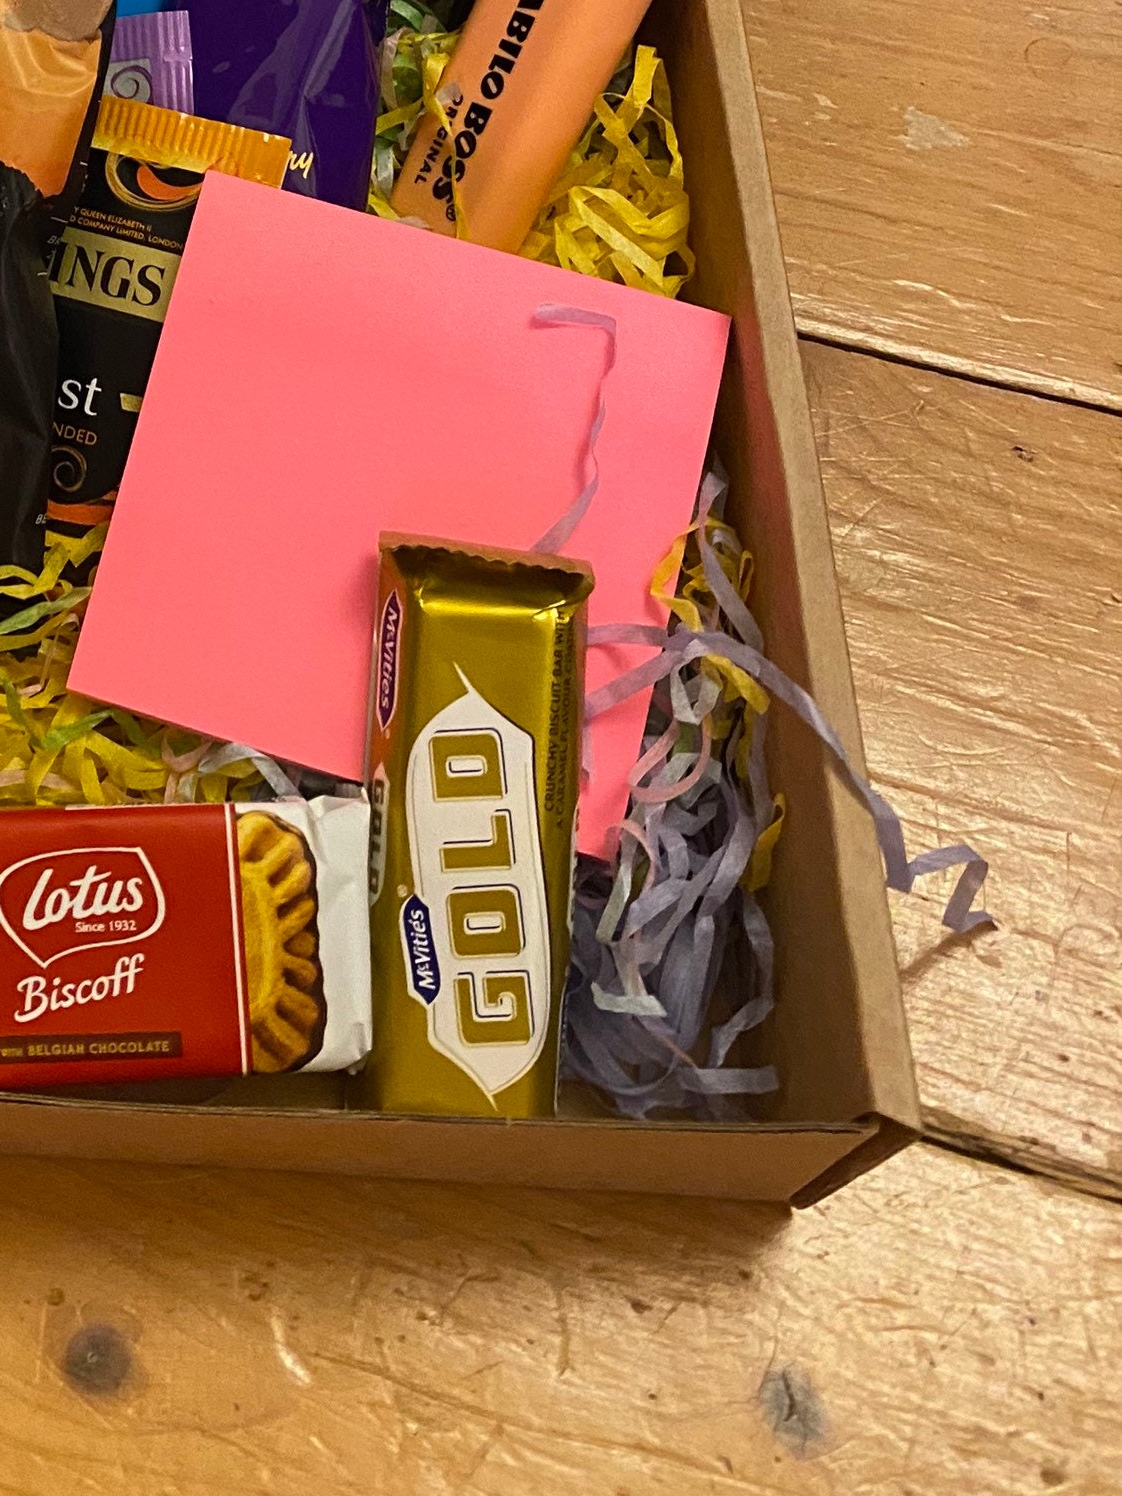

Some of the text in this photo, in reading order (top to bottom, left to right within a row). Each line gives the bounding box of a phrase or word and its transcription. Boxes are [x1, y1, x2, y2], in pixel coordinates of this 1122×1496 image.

[433, 102, 492, 204] BOSS
[78, 217, 114, 232] COMPANY
[80, 208, 106, 221] QUEEN
[48, 241, 166, 306] INGS
[53, 421, 97, 446] NDED
[22, 865, 144, 931] Lotus
[429, 729, 535, 1048] GOLD
[75, 919, 137, 933] Since 1932
[14, 952, 145, 1023] Biscoff
[27, 1043, 85, 1057] BELGIAN
[89, 1040, 170, 1054] CHOCOLATE
